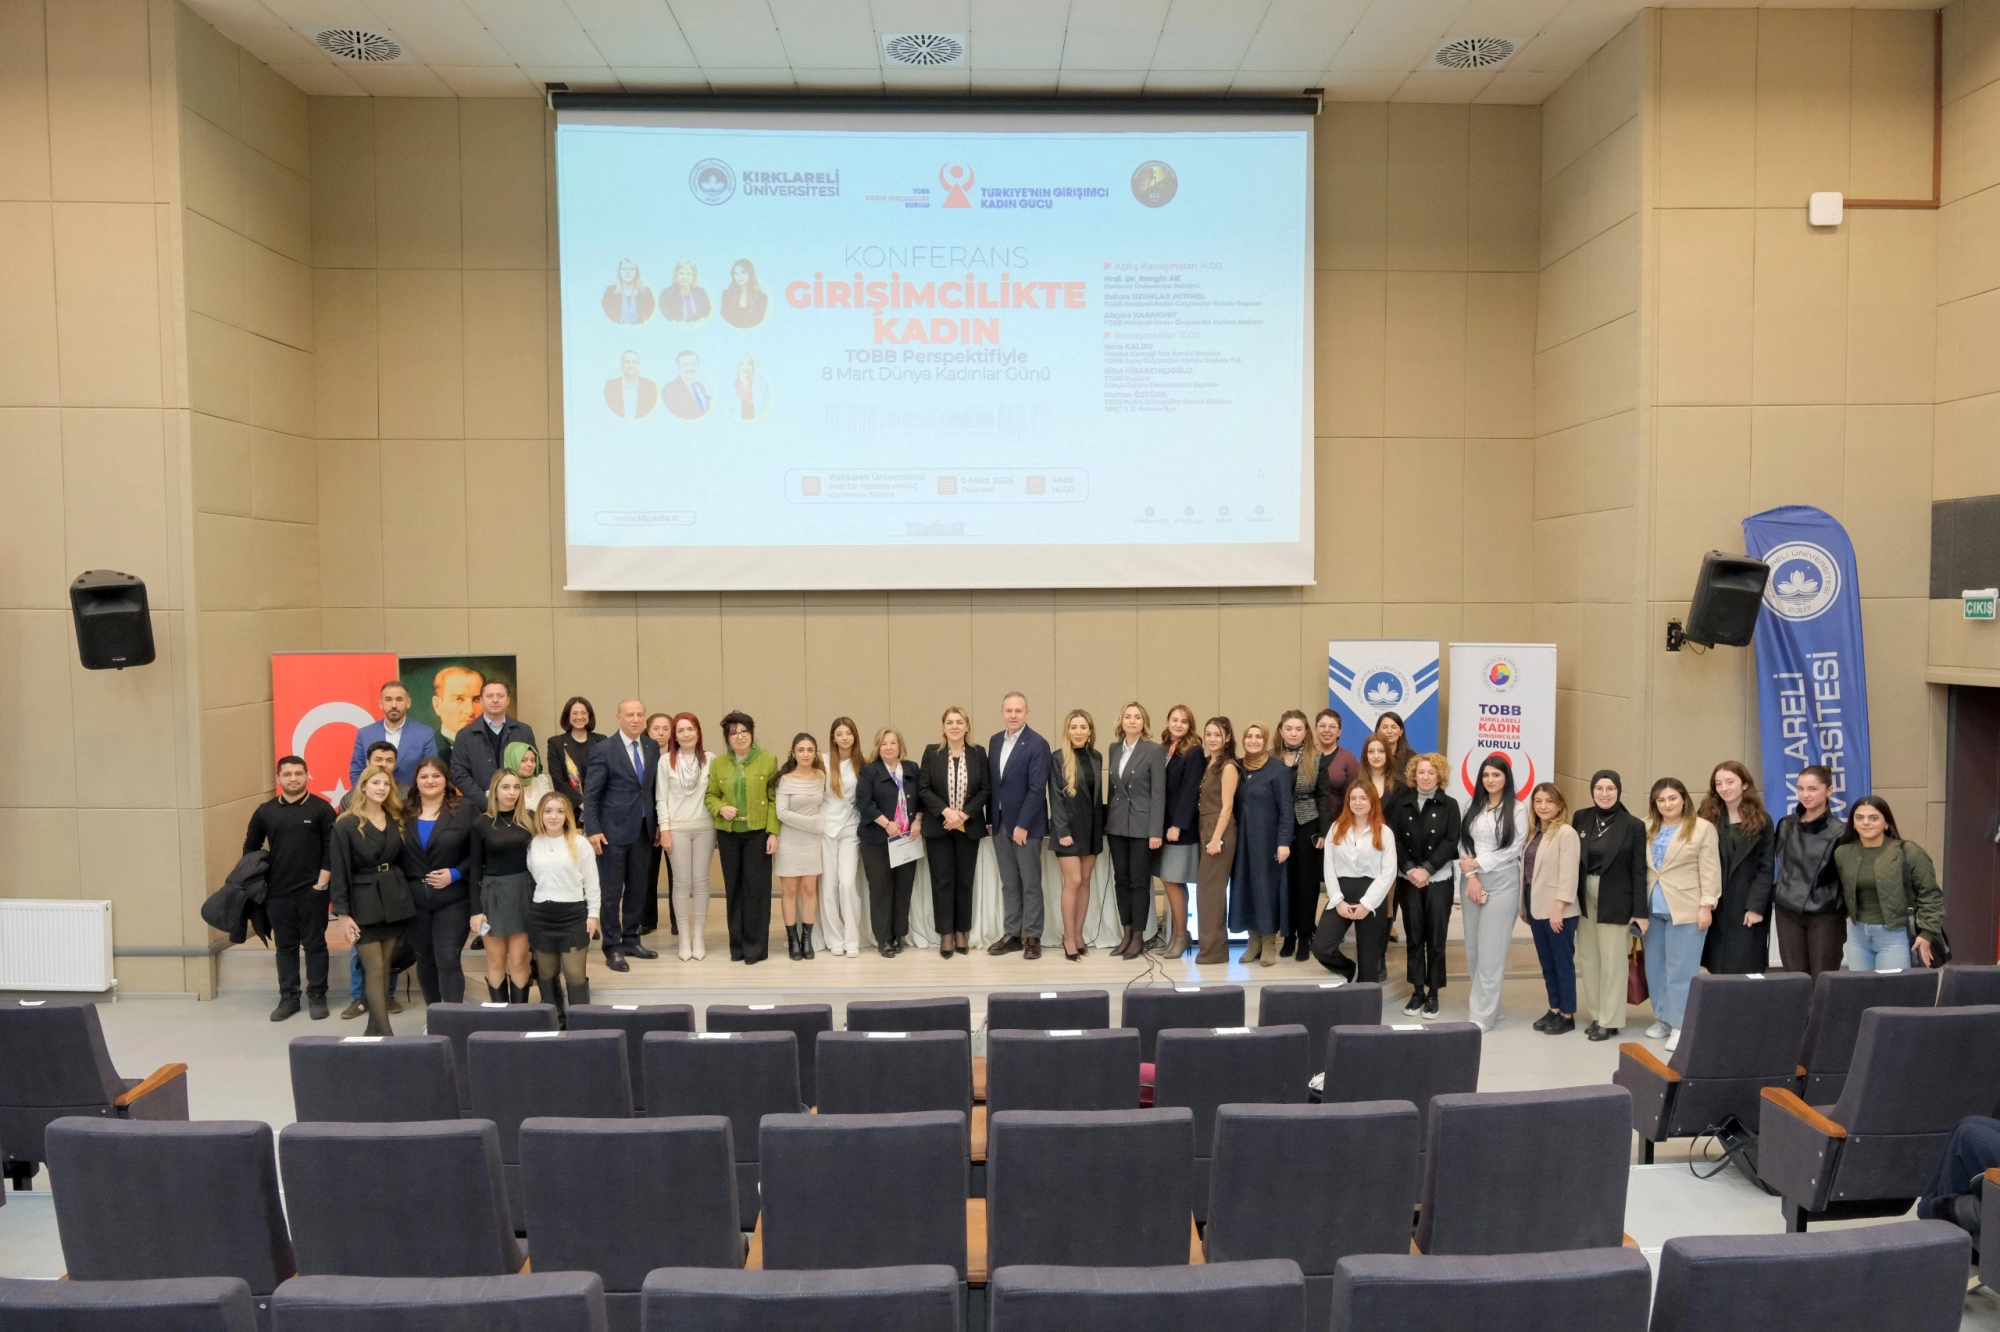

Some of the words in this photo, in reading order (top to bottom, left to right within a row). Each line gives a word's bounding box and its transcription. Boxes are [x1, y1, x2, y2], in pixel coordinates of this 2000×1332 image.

[743, 169, 840, 183] KIRKLARELİ
[743, 182, 840, 196] ÜNİVERSİTESİ
[981, 199, 1017, 208] KADIN
[845, 245, 1029, 269] KONFERANS
[1200, 262, 1222, 270] 14:00
[785, 271, 1086, 316] GİRİŞİMCİLİKTE
[873, 318, 999, 345] KADIN
[844, 349, 897, 363] TOBB
[902, 349, 1028, 365] Perspektifiyle
[822, 367, 833, 380] 8
[837, 367, 874, 380] Mart
[879, 366, 931, 383] Dünya
[936, 366, 1002, 380] Kadınlar
[1004, 366, 1050, 380] Günü
[1052, 475, 1075, 483] Saat:
[1791, 549, 1832, 596] ÜNİVERSİTESİ
[1787, 605, 1812, 614] 2007
[1966, 601, 1994, 616] ÇIKIŞ
[1479, 704, 1521, 715] TOBB
[1479, 723, 1520, 733] KADIN
[1478, 740, 1520, 750] KURULU
